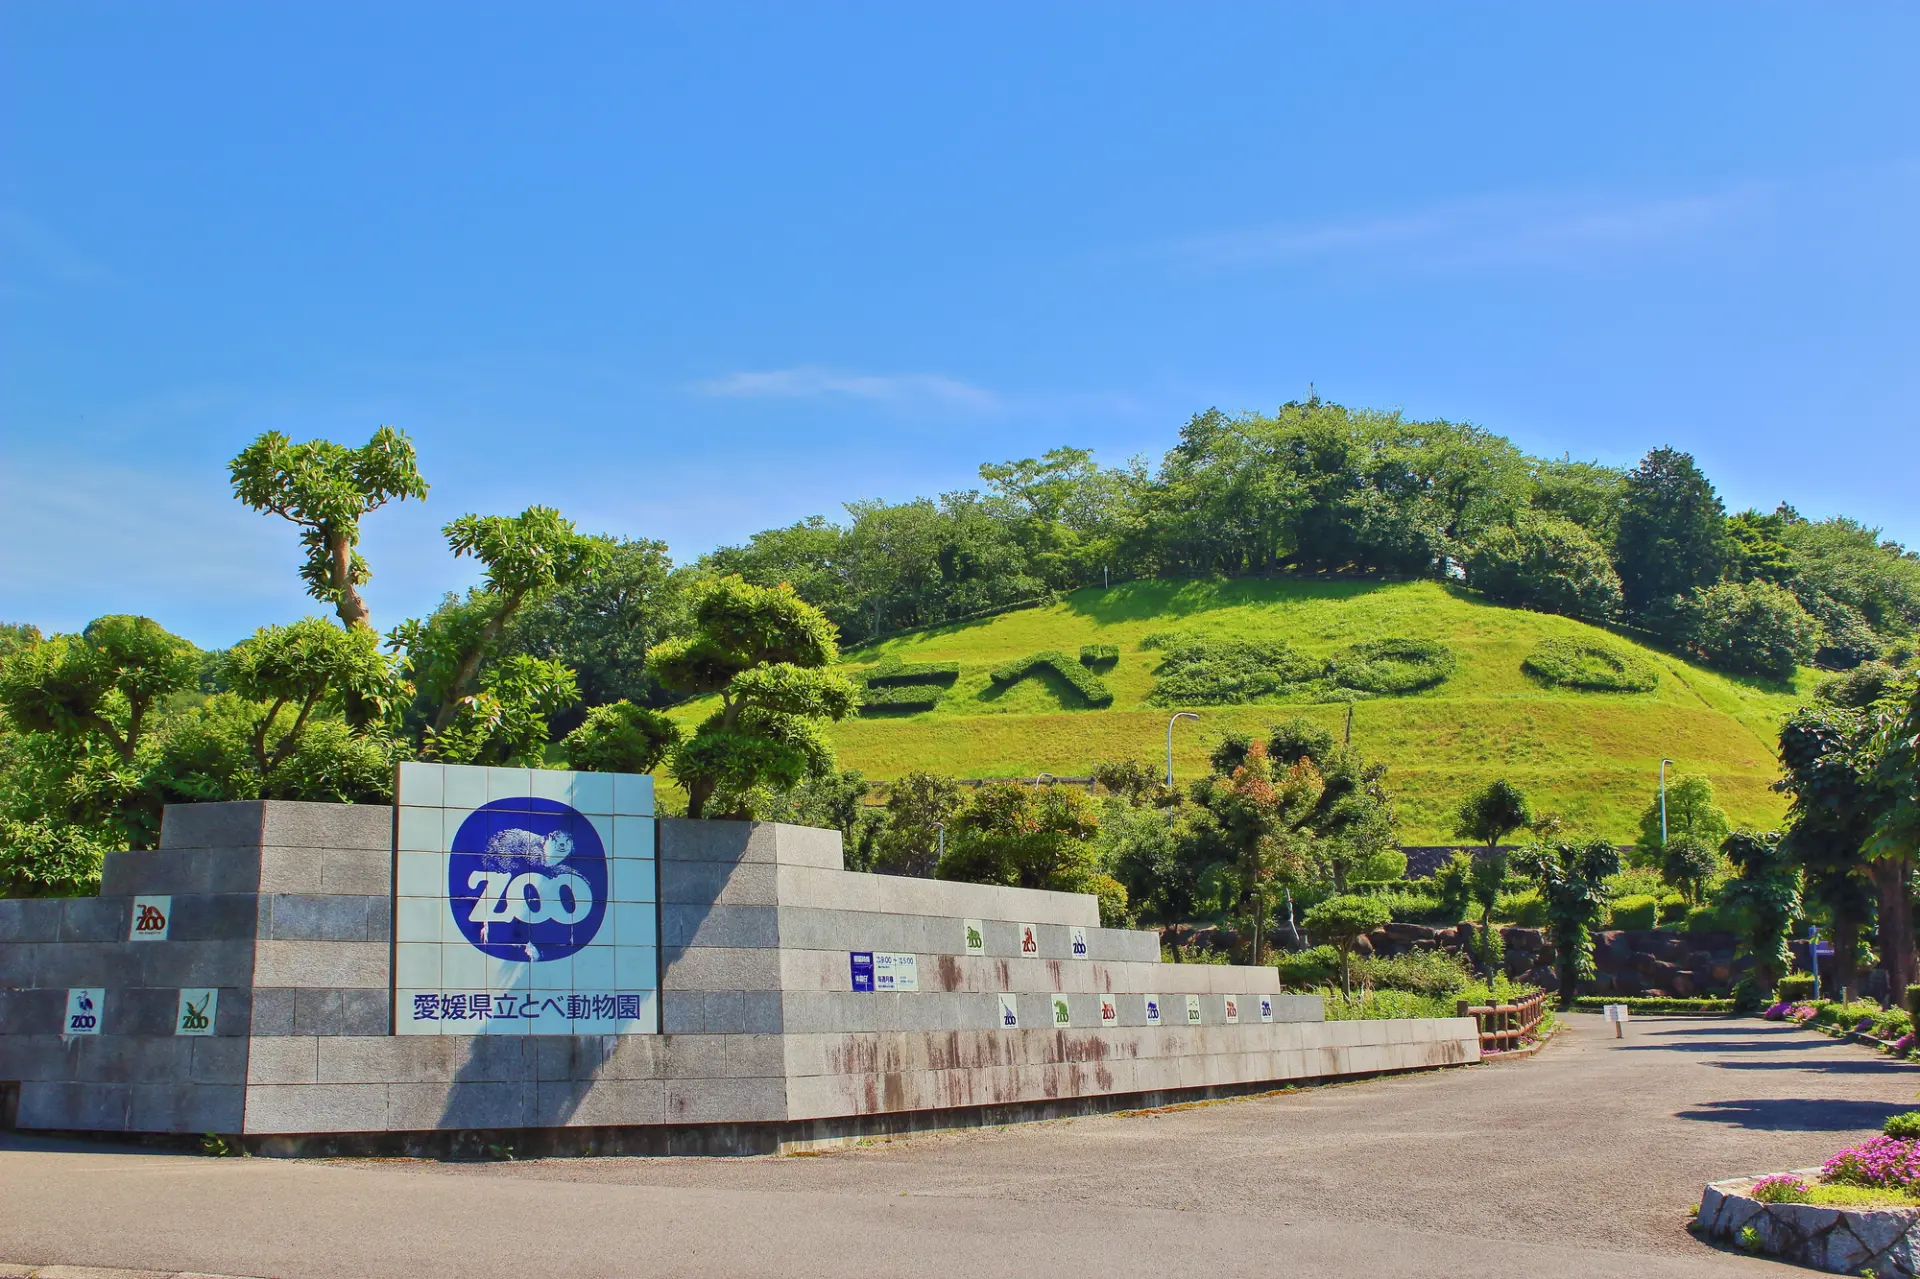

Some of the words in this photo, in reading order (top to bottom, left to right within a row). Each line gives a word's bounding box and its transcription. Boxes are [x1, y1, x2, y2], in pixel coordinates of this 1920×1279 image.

[467, 870, 593, 925] ZOO
[135, 916, 166, 931] ZOO
[1073, 943, 1087, 954] ZOO
[413, 993, 641, 1020] 愛媛県立とべ動物園
[1147, 1008, 1159, 1019] ZOO
[70, 1015, 97, 1029] ZOO
[182, 1015, 209, 1029] ZOO
[1004, 1015, 1016, 1026] ZOO
[1056, 1012, 1069, 1023] ZOO
